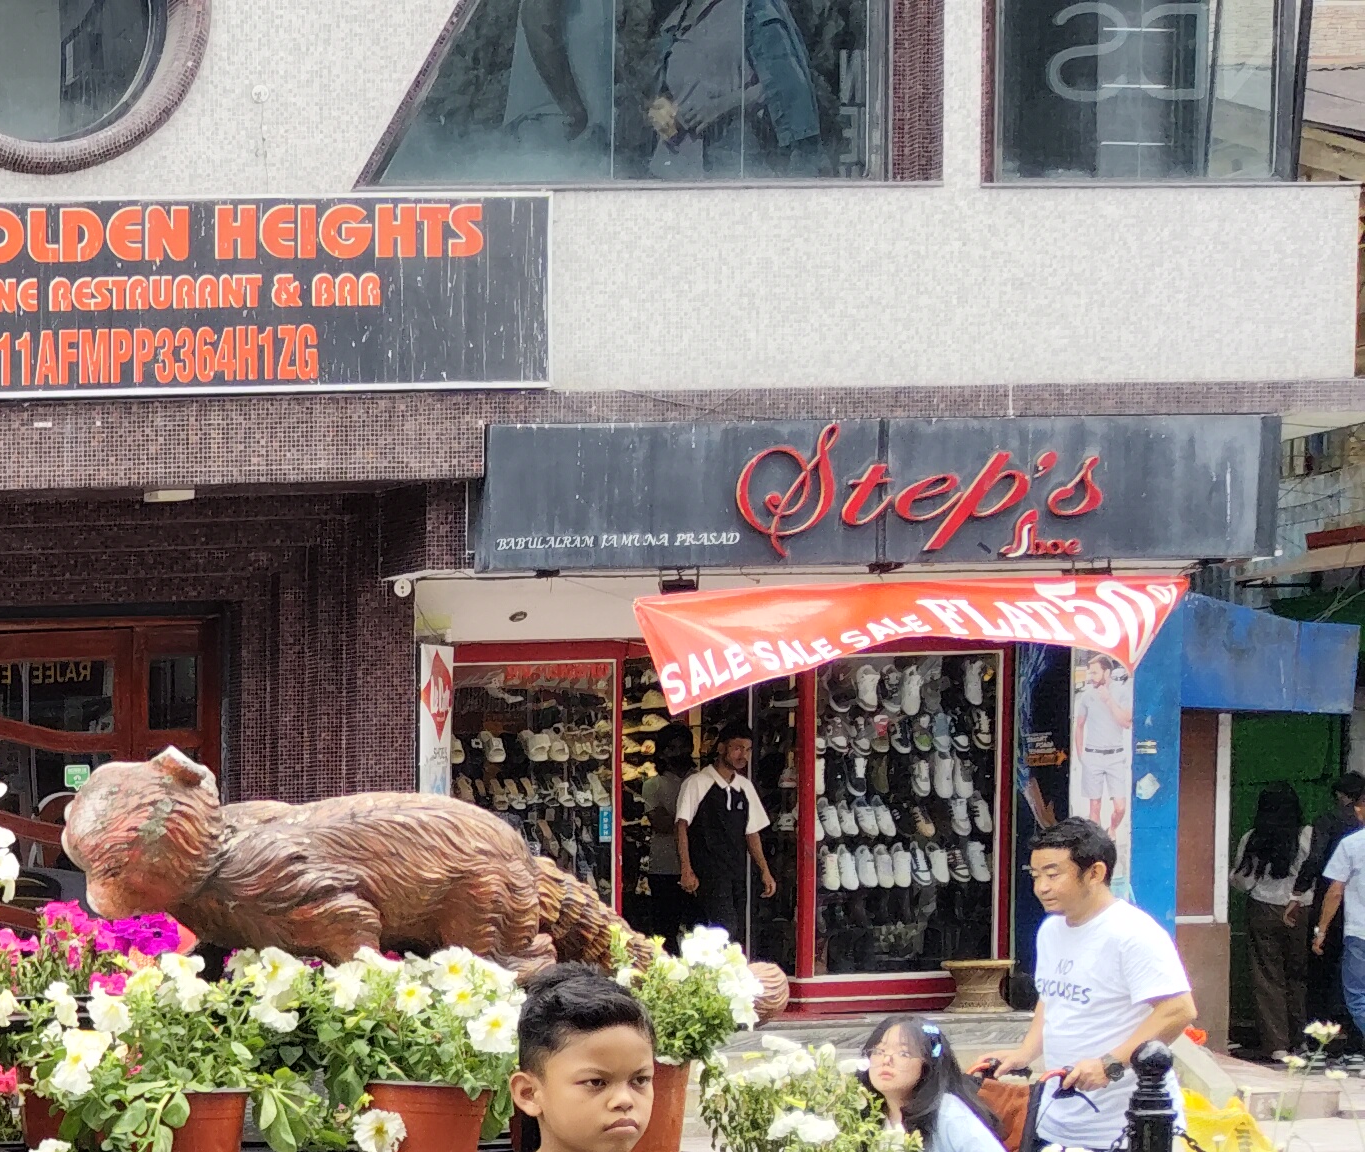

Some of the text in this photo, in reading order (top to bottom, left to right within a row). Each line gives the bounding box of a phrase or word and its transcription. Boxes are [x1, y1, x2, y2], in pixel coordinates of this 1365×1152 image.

[215, 204, 485, 260] HEIGHTS
[50, 275, 264, 312] RESTAURANT
[272, 275, 302, 308] &
[313, 274, 383, 307] BAR
[735, 423, 1105, 558] Step's
[673, 531, 741, 547] PRASAD
[660, 637, 752, 702] SALE
[751, 636, 848, 674] SALE
[839, 613, 924, 650] SALE
[916, 596, 1059, 643] FLAT
[1055, 959, 1074, 975] NO
[1036, 978, 1092, 1004] EXCUSES
